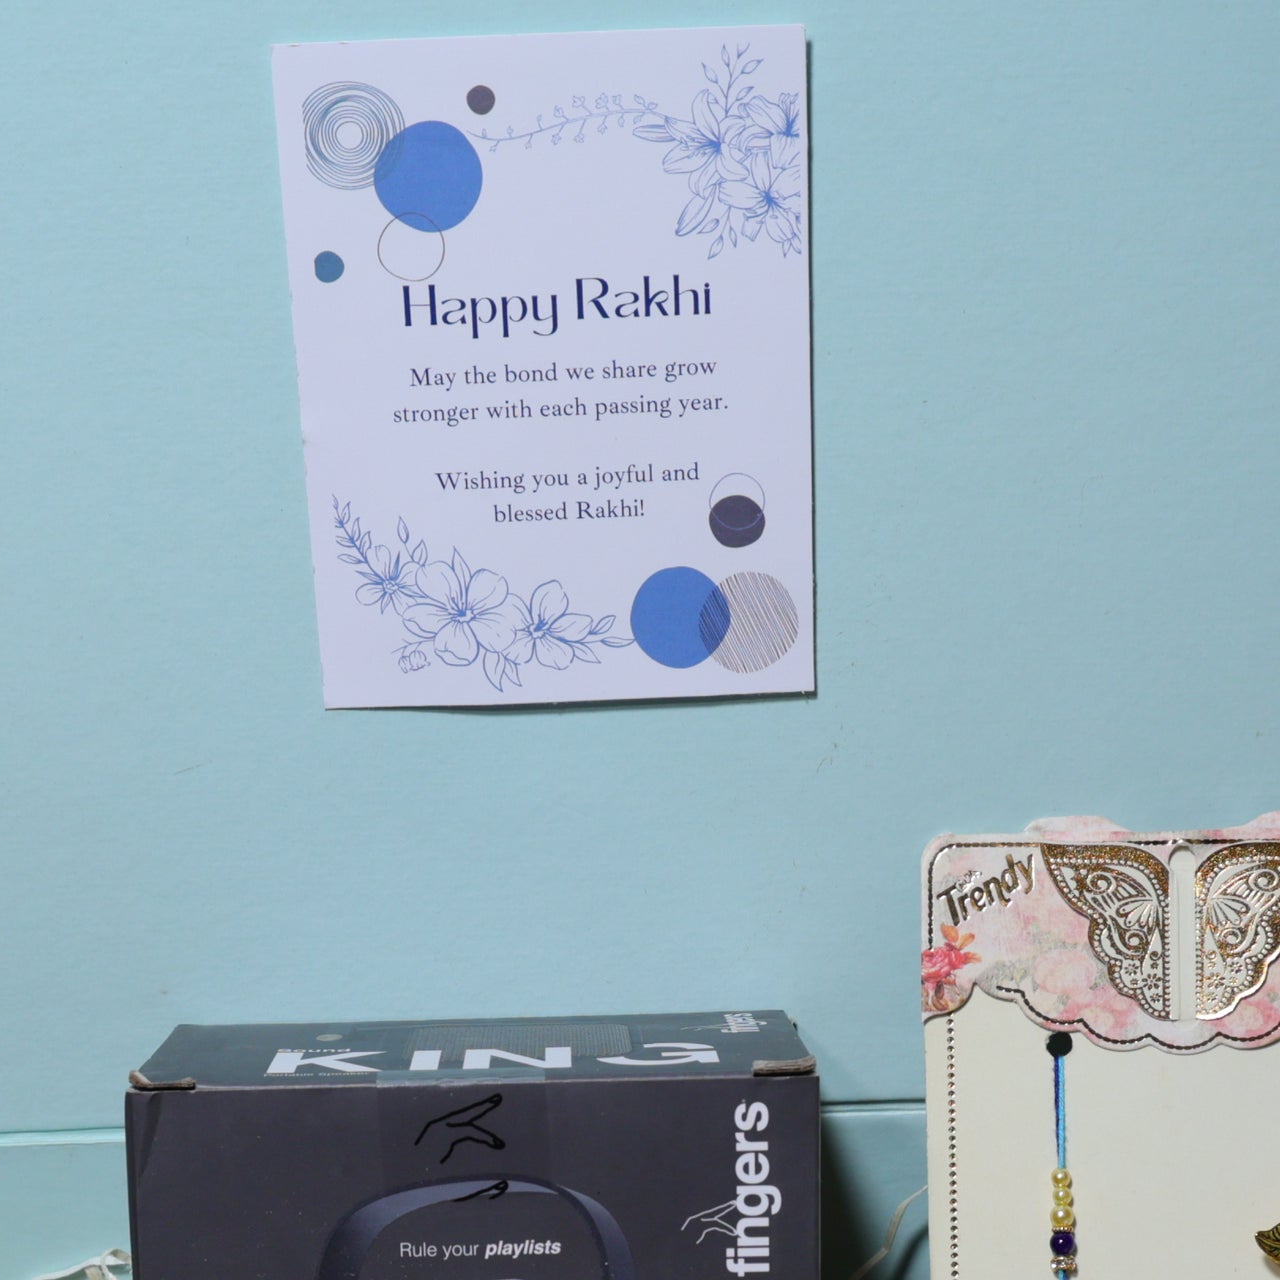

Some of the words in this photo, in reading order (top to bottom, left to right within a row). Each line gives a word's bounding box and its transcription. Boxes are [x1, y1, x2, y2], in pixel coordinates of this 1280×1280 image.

[402, 284, 559, 339] Happy
[575, 274, 712, 320] Rakhi
[409, 367, 456, 391] May
[464, 365, 496, 385] the
[504, 362, 558, 383] bond
[565, 364, 595, 381] we
[602, 360, 657, 379] share
[665, 360, 717, 383] grow
[393, 405, 479, 427] stronger
[486, 399, 533, 420] with
[539, 397, 587, 418] each
[595, 395, 672, 421] passing
[678, 396, 729, 418] year.
[434, 470, 526, 494] Wishing
[531, 473, 569, 493] you
[577, 473, 588, 486] a
[593, 463, 654, 490] joyful
[661, 462, 700, 482] and
[493, 501, 568, 523] blessed
[576, 499, 646, 520] Rakhi!
[936, 853, 1033, 927] Trendy
[264, 1042, 720, 1074] KING
[726, 1101, 782, 1277] fingers
[400, 1242, 437, 1258] Rule
[442, 1244, 479, 1261] your
[484, 1239, 561, 1260] playlists
